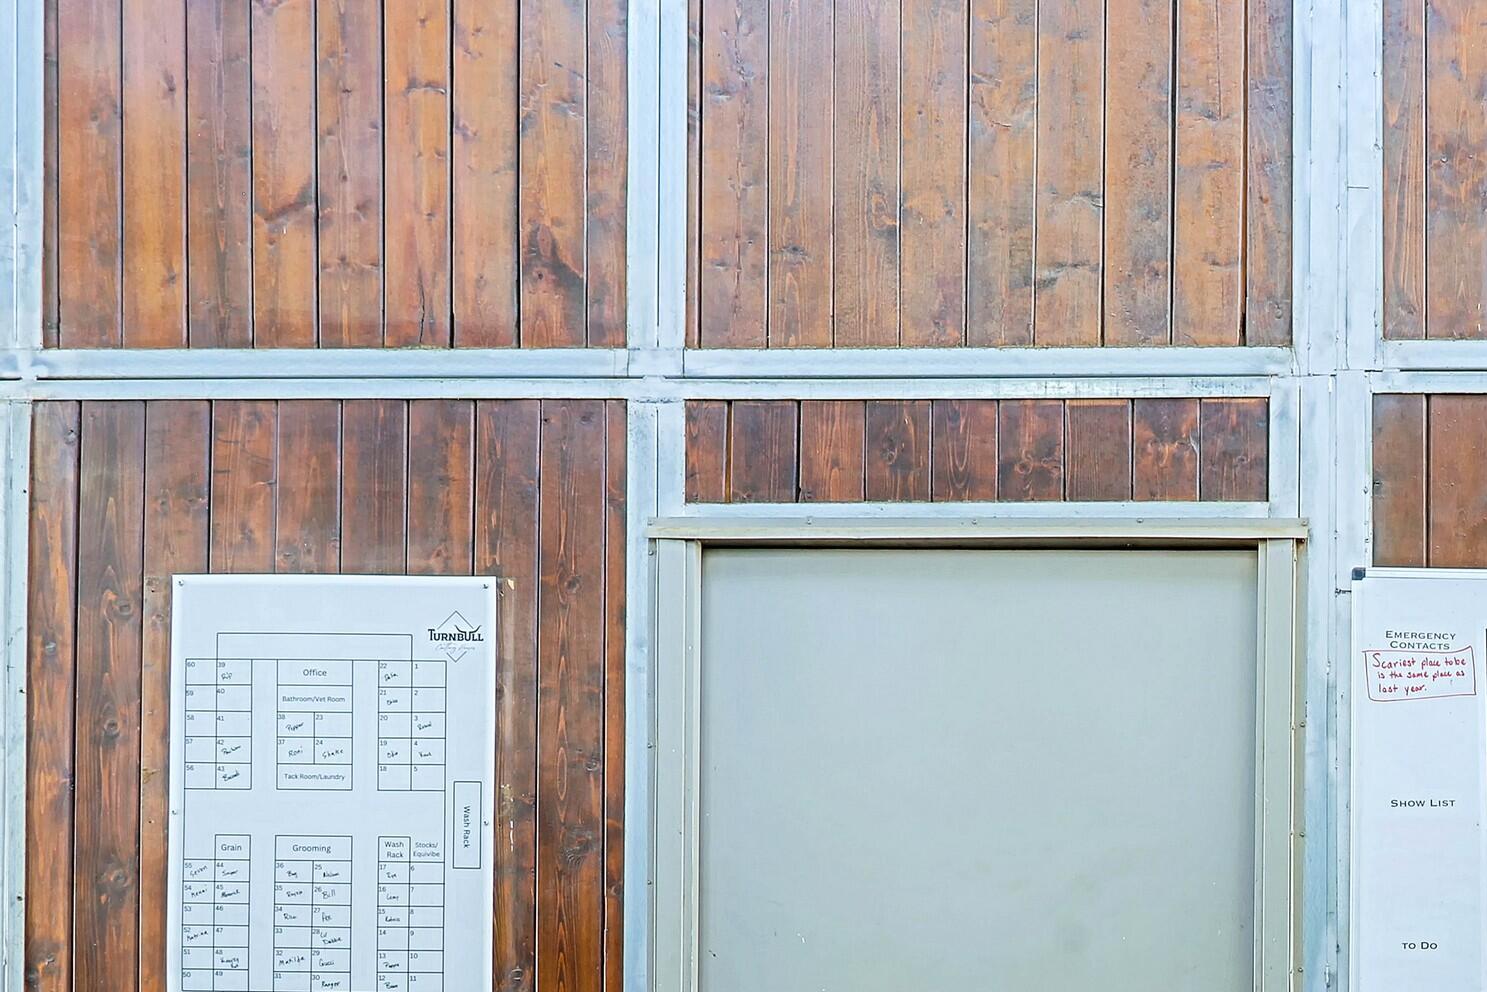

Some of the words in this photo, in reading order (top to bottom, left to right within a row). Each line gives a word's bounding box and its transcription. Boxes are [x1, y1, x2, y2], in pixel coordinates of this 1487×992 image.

[428, 627, 484, 642] TURNBULL
[1386, 631, 1456, 640] EMERGENCY
[1390, 641, 1450, 650] CONTACTS
[1373, 653, 1416, 669] Scariest
[303, 669, 327, 677] Office
[300, 773, 345, 781] Room/Laundry
[1391, 799, 1425, 807] SHOW
[1430, 799, 1456, 807] LIST
[463, 806, 471, 828] Wash
[292, 845, 331, 853] Grooming
[413, 850, 440, 858] Equivibe
